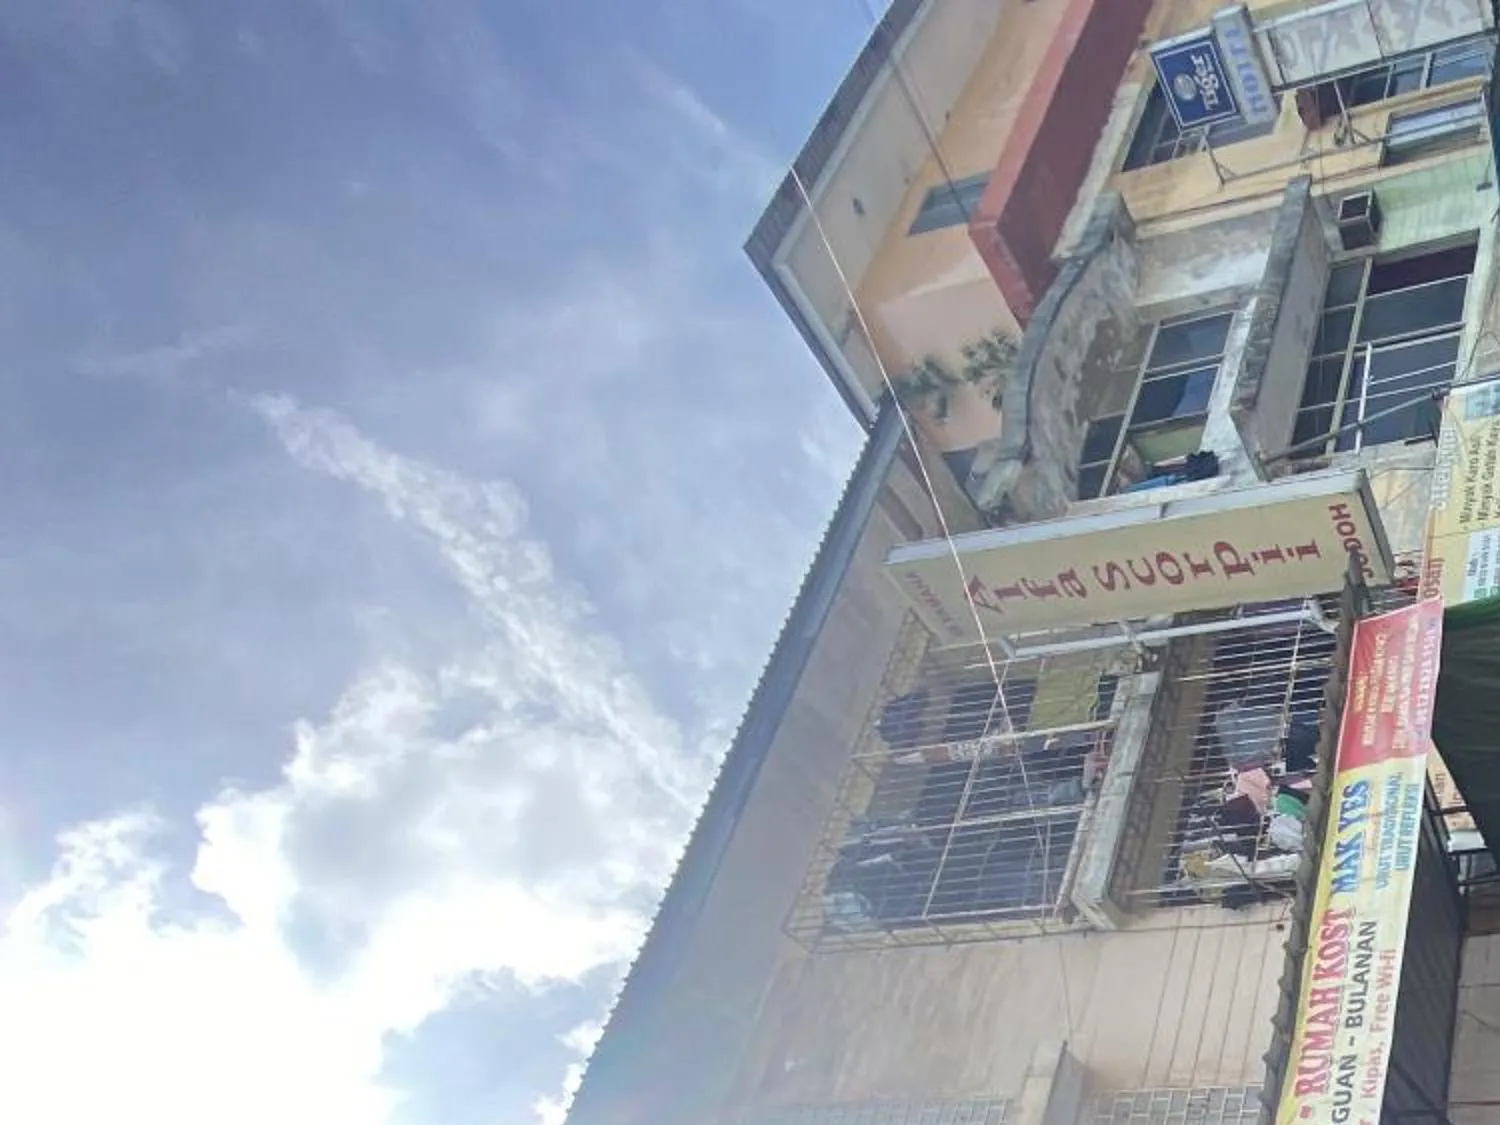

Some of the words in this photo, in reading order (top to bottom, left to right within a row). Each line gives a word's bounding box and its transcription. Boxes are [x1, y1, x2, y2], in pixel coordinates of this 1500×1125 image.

[1190, 53, 1220, 110] Tiger
[962, 567, 1088, 615] Alfa
[1092, 541, 1323, 592] Scorpii
[1337, 779, 1372, 833] YES
[1330, 831, 1366, 895] MAK
[1309, 906, 1357, 985] KOST
[1344, 920, 1379, 1028] BULANAN
[1293, 986, 1343, 1097] RUMAH
[1369, 993, 1392, 1033] Free
